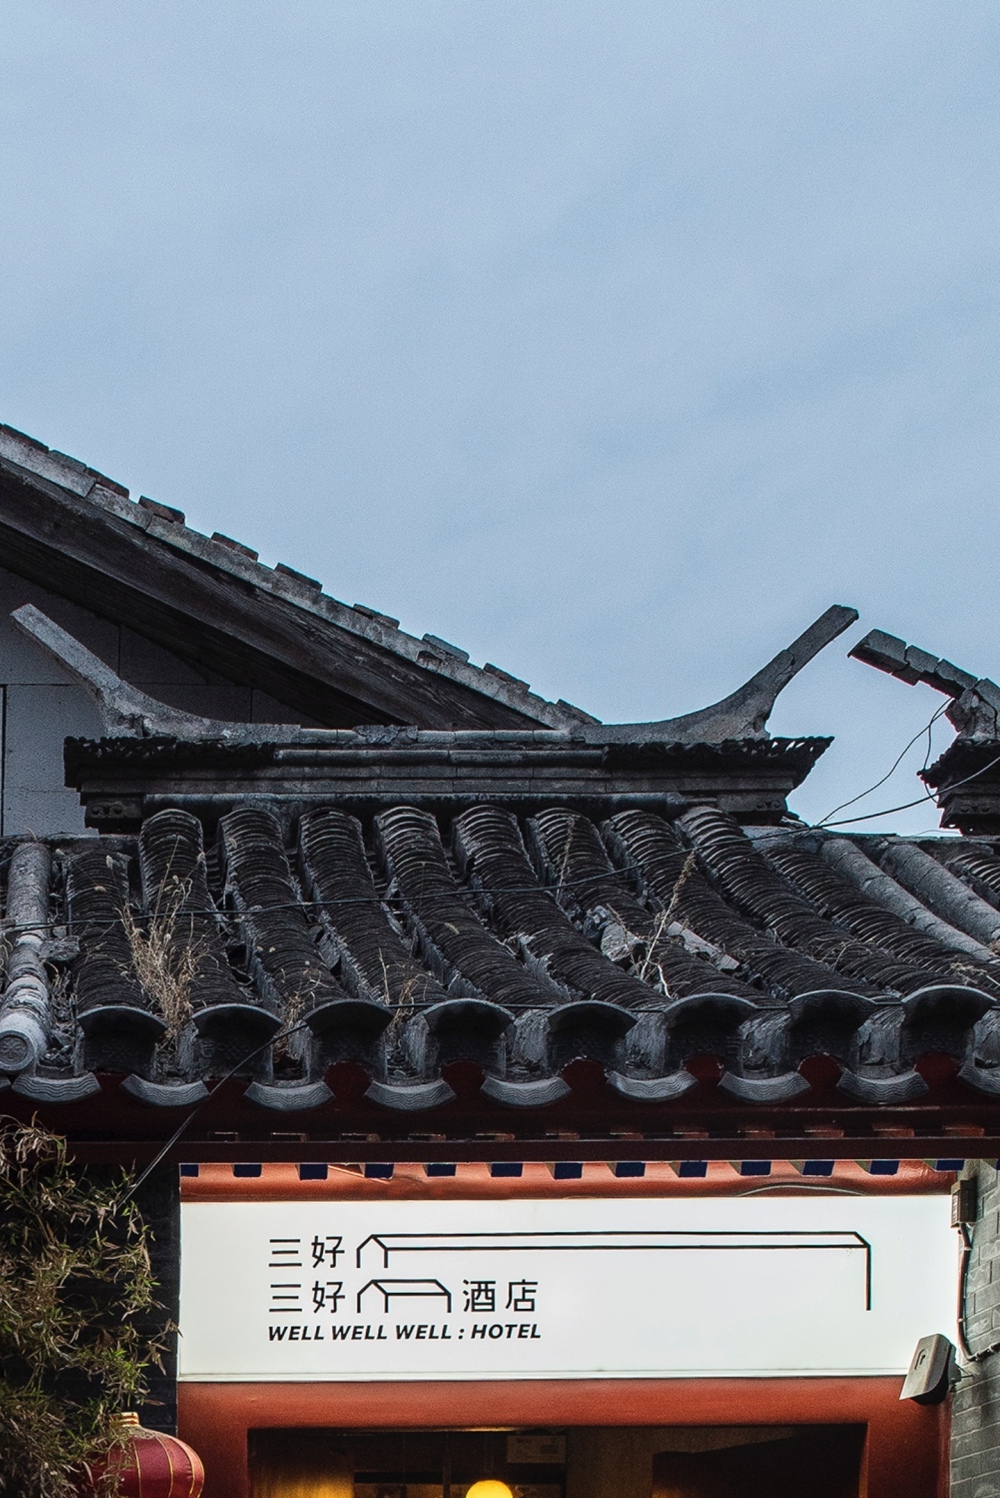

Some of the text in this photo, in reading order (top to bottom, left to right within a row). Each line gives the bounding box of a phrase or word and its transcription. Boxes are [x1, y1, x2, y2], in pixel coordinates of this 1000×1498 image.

[268, 1235, 345, 1268] 三好
[268, 1278, 538, 1313] 三好 酒店
[268, 1325, 325, 1341] WELL
[331, 1324, 388, 1340] WELL
[395, 1324, 452, 1340] WELL
[470, 1323, 542, 1340] HOTEL
